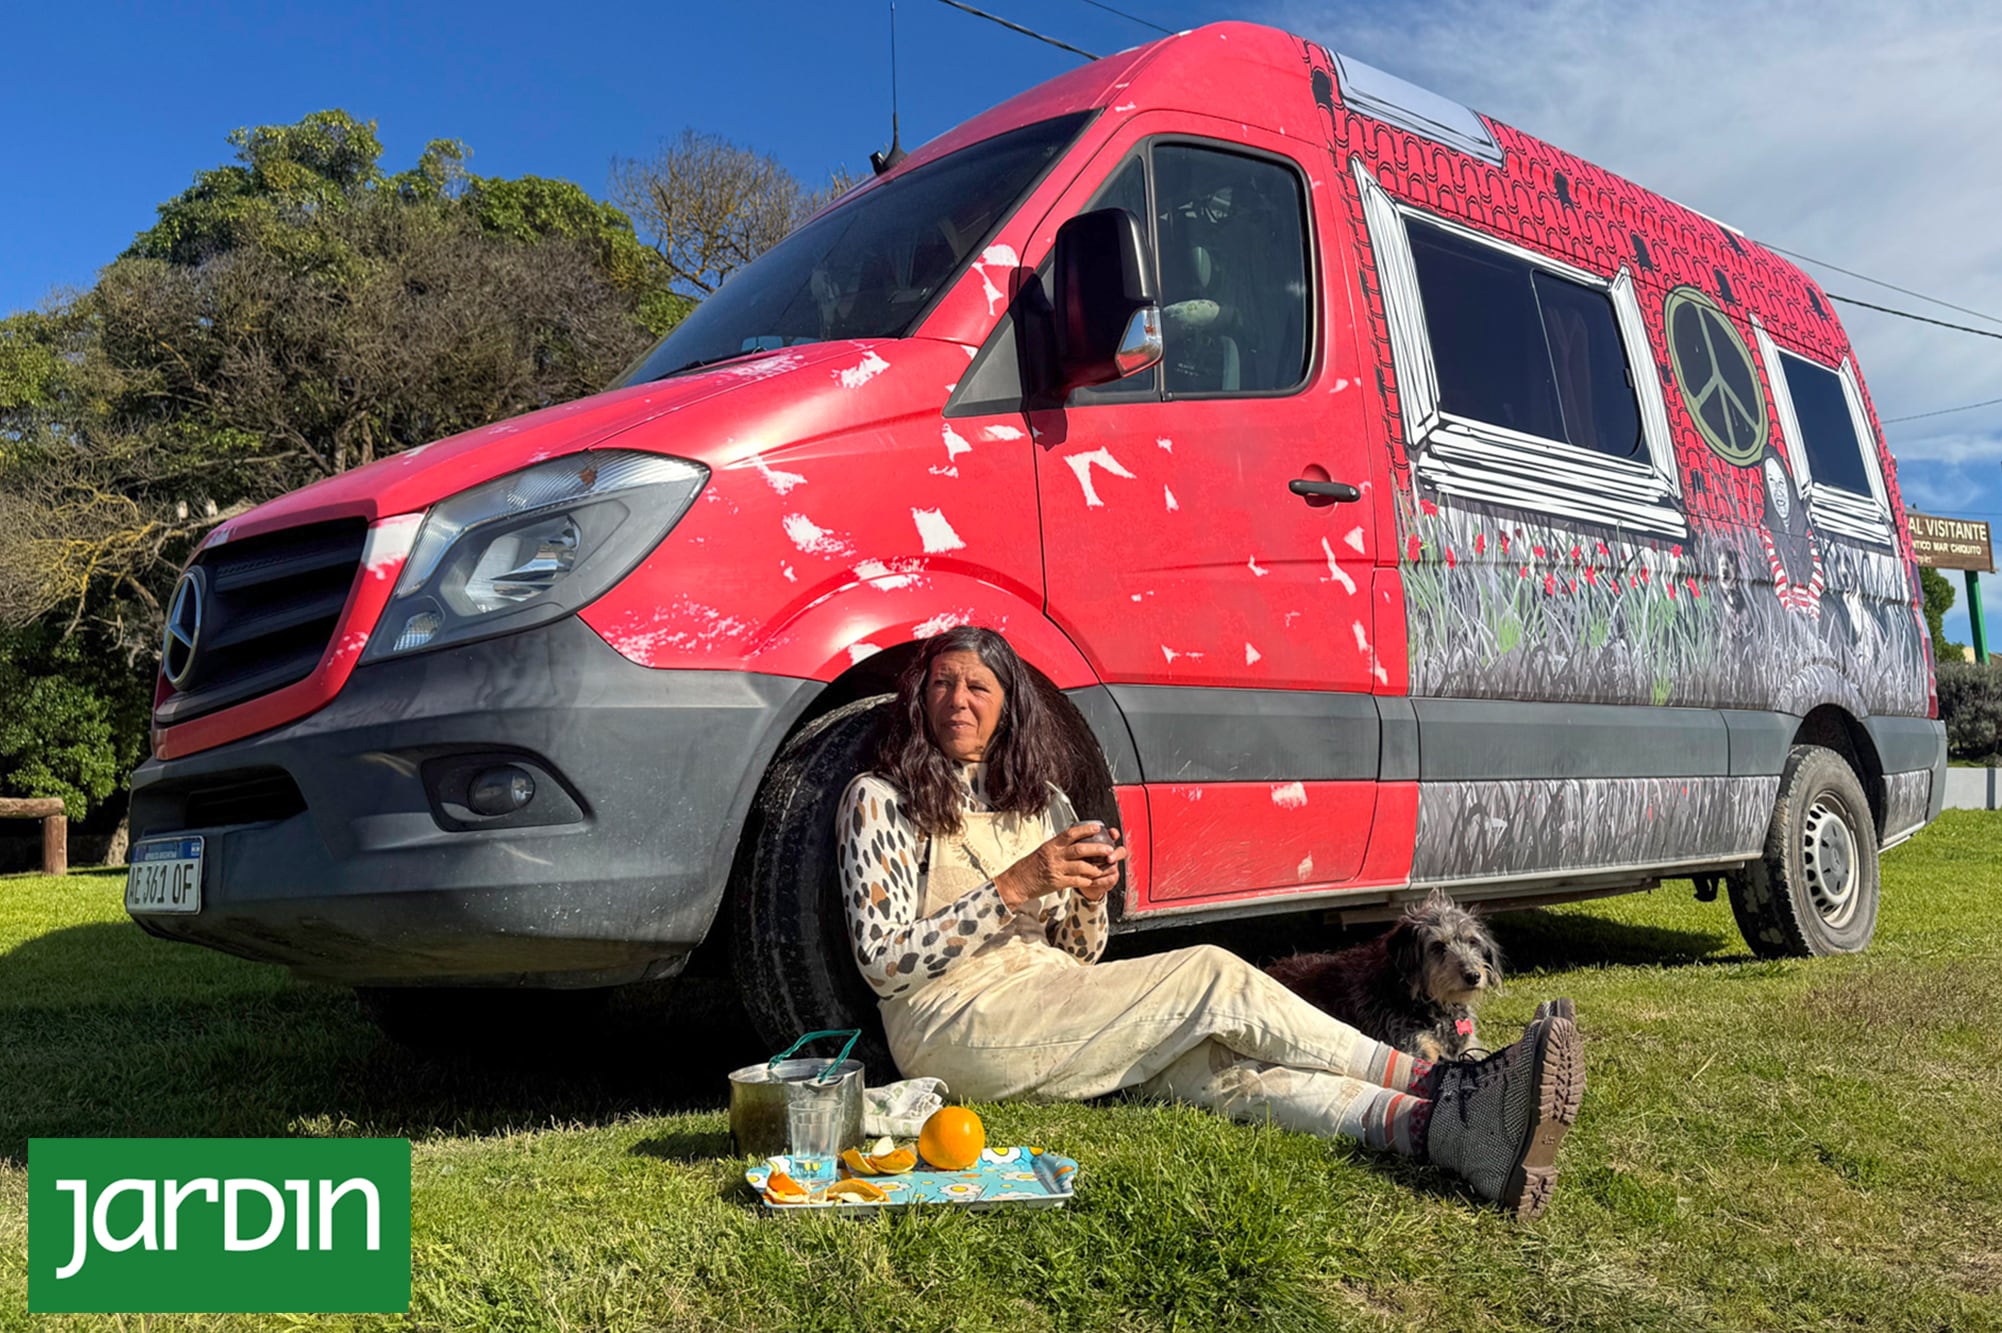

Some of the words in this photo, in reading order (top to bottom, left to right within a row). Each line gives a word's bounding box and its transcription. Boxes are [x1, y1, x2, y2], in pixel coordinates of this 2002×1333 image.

[1925, 518, 1988, 542] VISITANTE
[1950, 543, 1982, 556] CHIQUITO
[143, 864, 168, 904] 361
